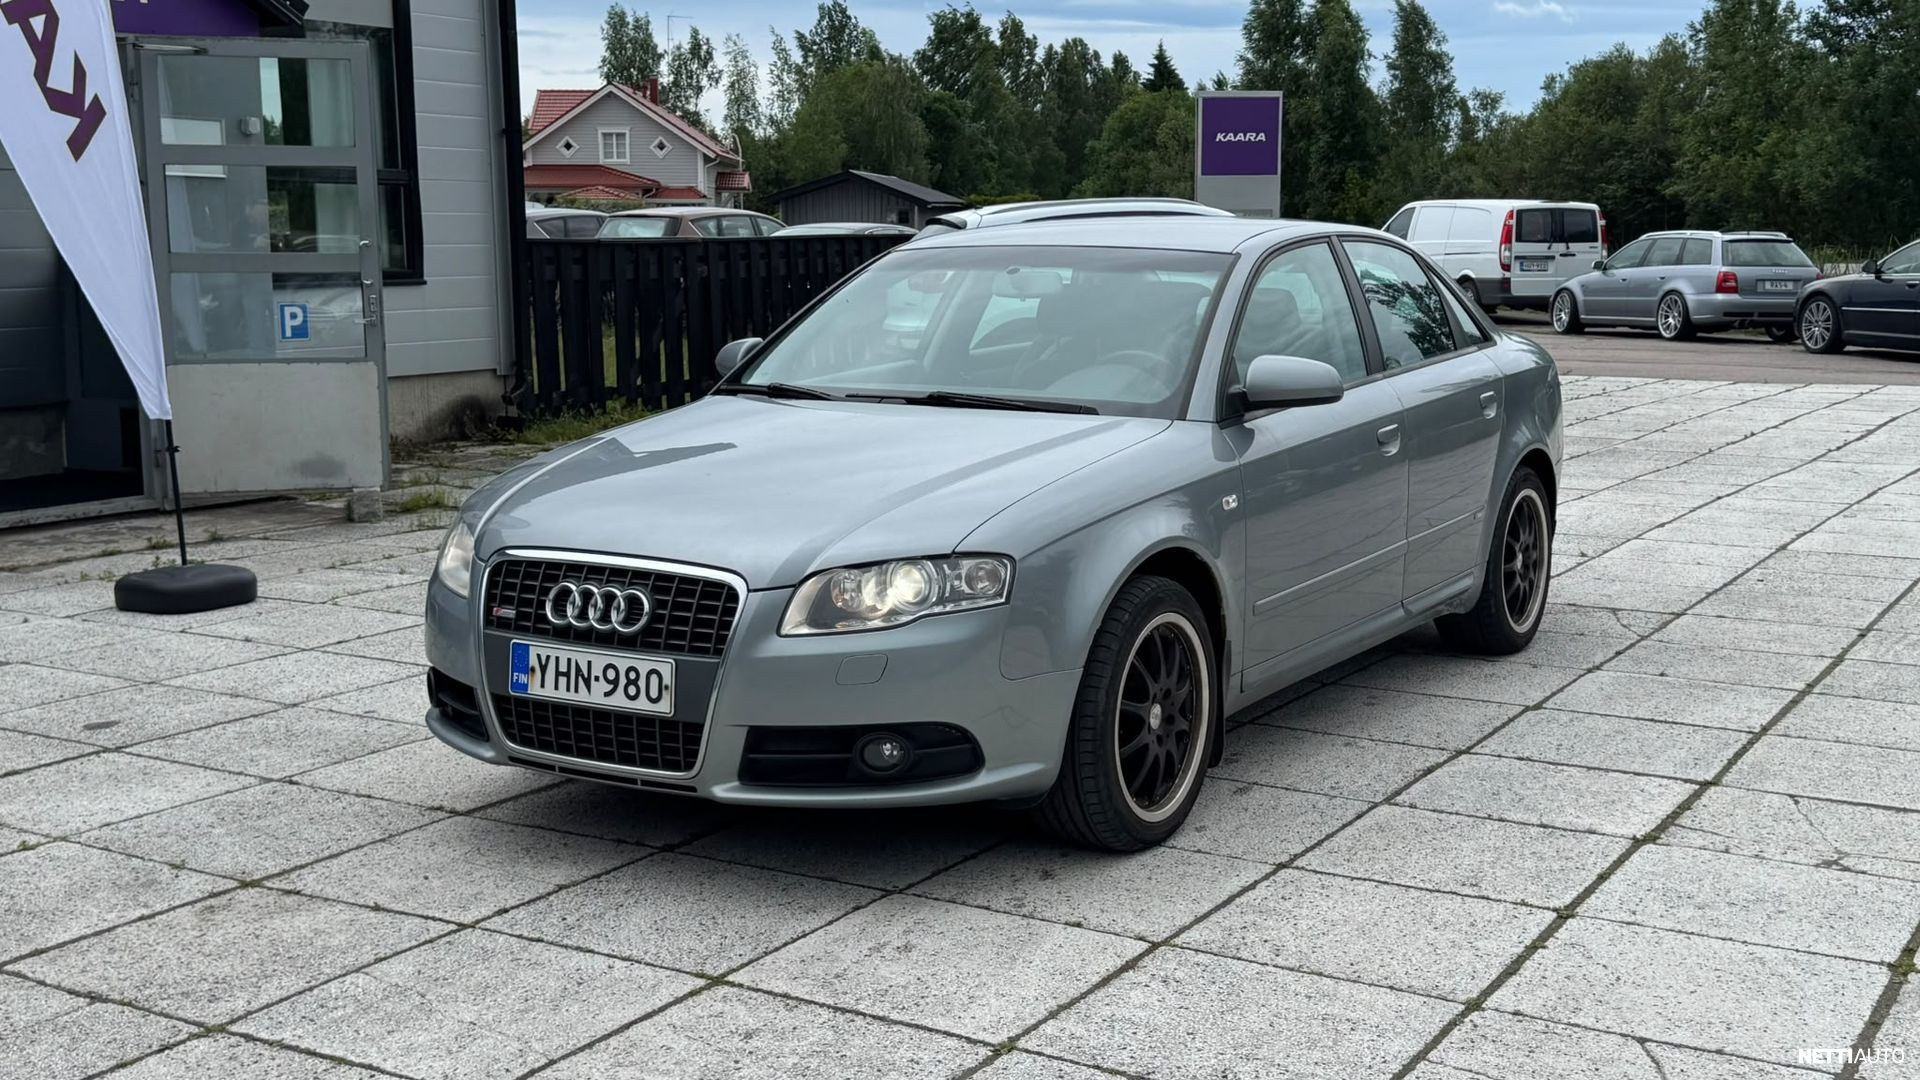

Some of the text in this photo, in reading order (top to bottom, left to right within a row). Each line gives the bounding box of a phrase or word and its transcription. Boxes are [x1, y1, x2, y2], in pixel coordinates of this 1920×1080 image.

[1215, 132, 1266, 142] KAARA
[284, 307, 303, 337] P
[513, 672, 528, 684] FIN
[536, 653, 664, 704] YHN-980
